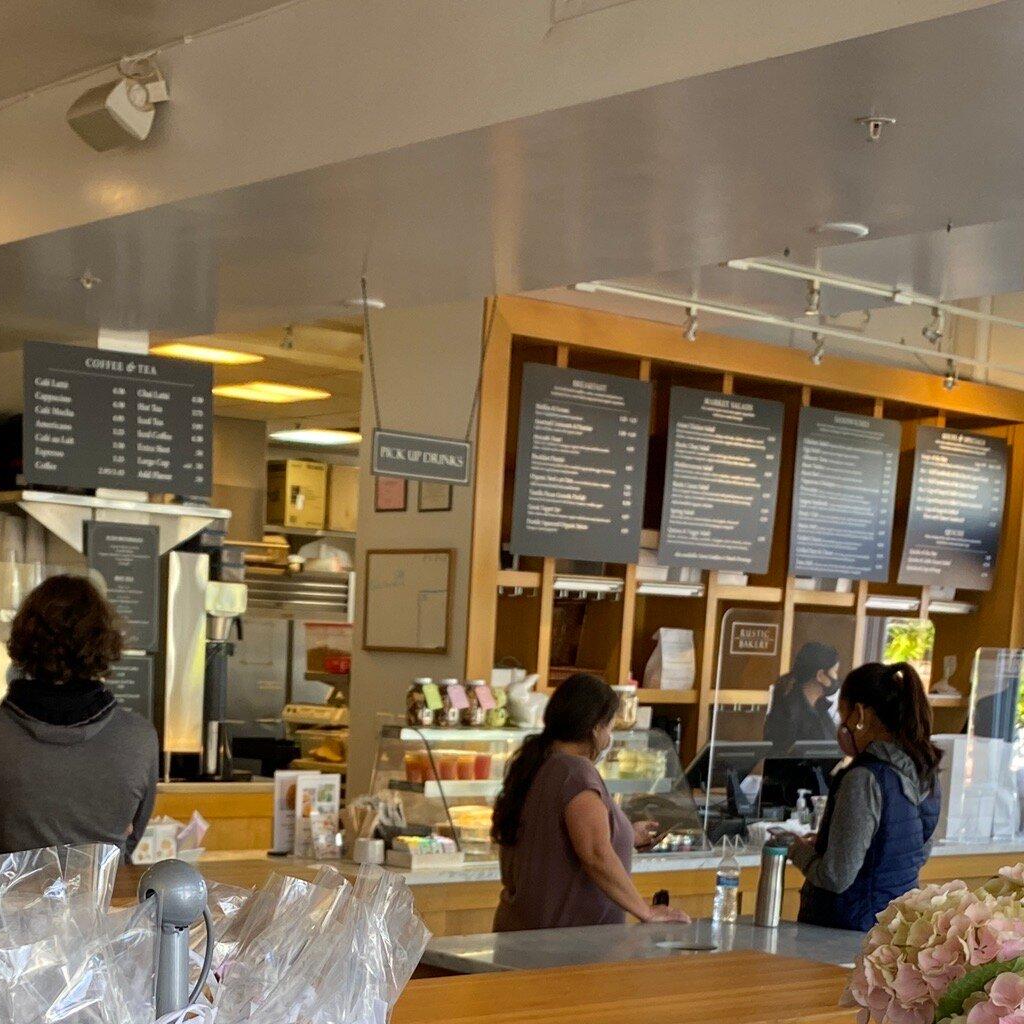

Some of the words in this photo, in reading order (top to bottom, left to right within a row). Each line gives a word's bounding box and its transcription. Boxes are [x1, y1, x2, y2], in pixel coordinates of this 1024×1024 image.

[85, 357, 125, 372] COFFEE
[126, 361, 137, 373] &
[138, 364, 157, 375] TEA
[380, 446, 407, 460] PICK
[407, 450, 422, 462] UP
[422, 452, 465, 468] DRINKS
[34, 461, 58, 471] Coffee
[739, 628, 771, 639] RUSTIC
[738, 640, 770, 650] BAKERY
